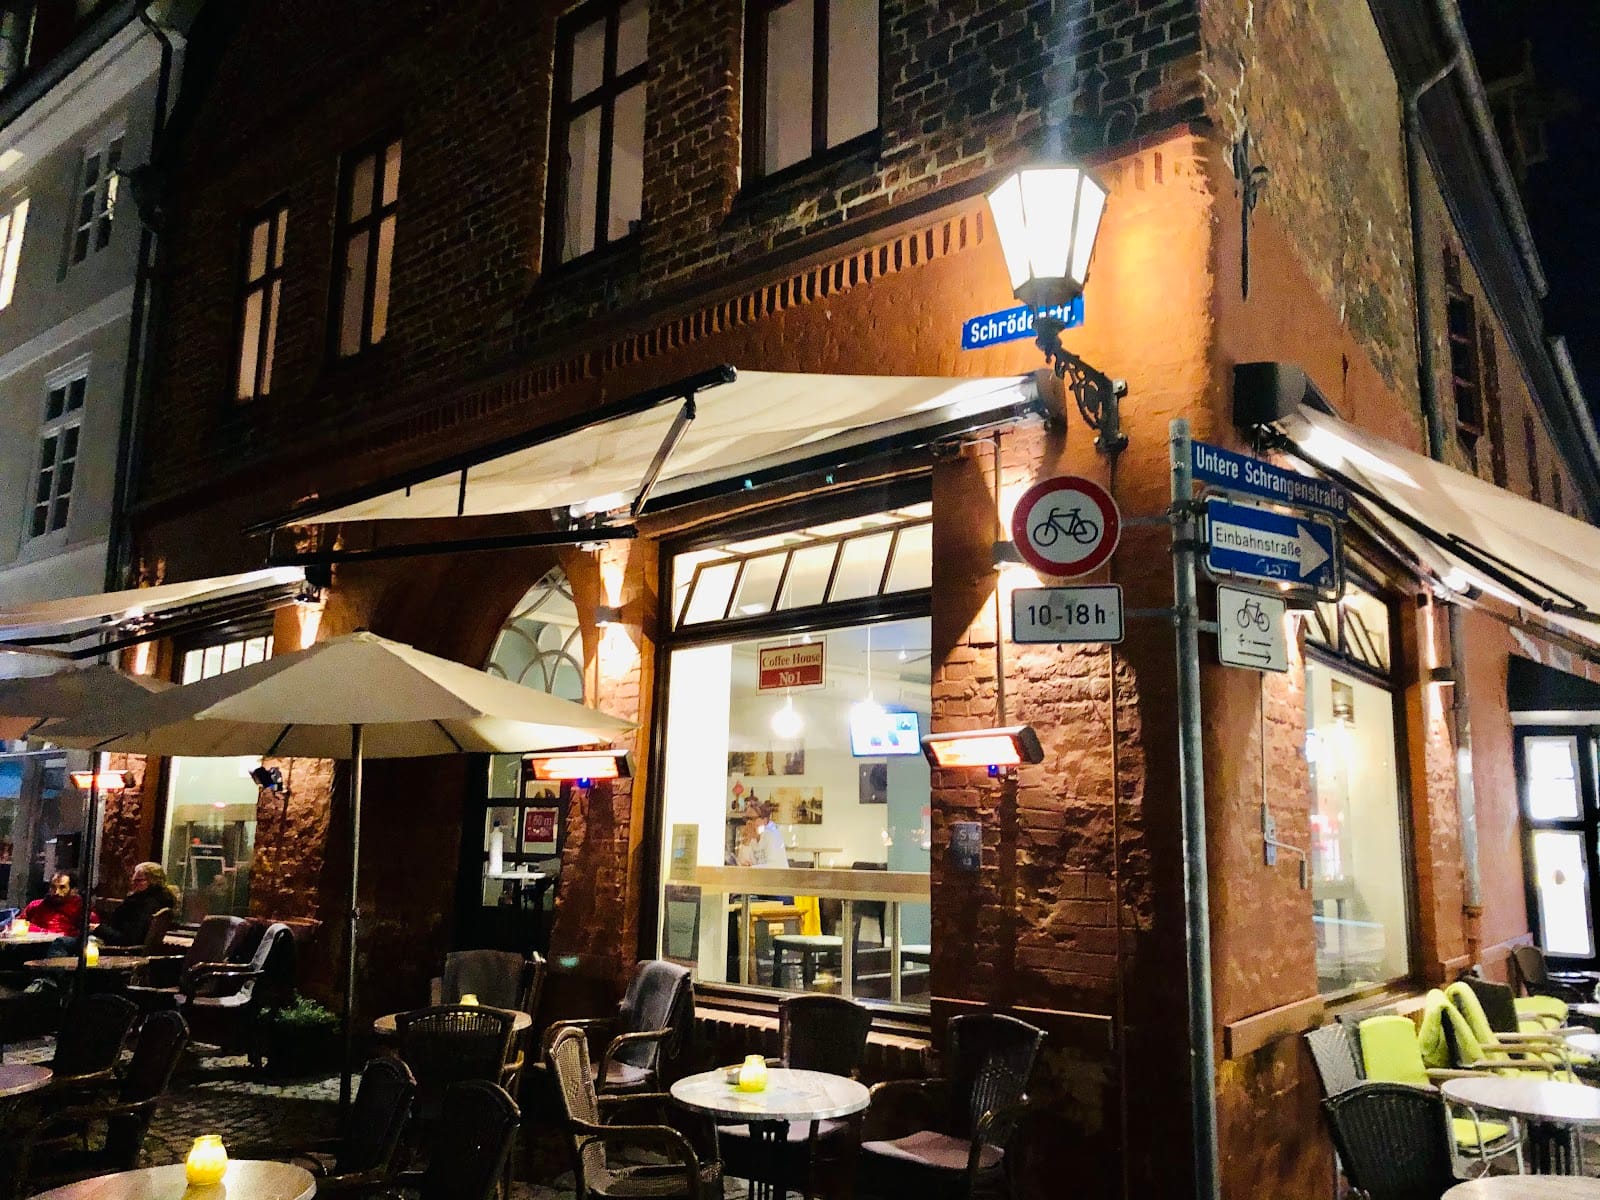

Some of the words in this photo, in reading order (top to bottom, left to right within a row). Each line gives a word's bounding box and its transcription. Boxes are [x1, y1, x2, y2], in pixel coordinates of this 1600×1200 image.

[1196, 446, 1239, 479] Untere
[1244, 461, 1345, 511] Schrangenstraße
[1215, 526, 1302, 557] Einbahnstraße
[1028, 603, 1090, 626] 10-18
[1095, 603, 1106, 624] h
[762, 655, 790, 668] Coffee
[792, 652, 820, 665] House
